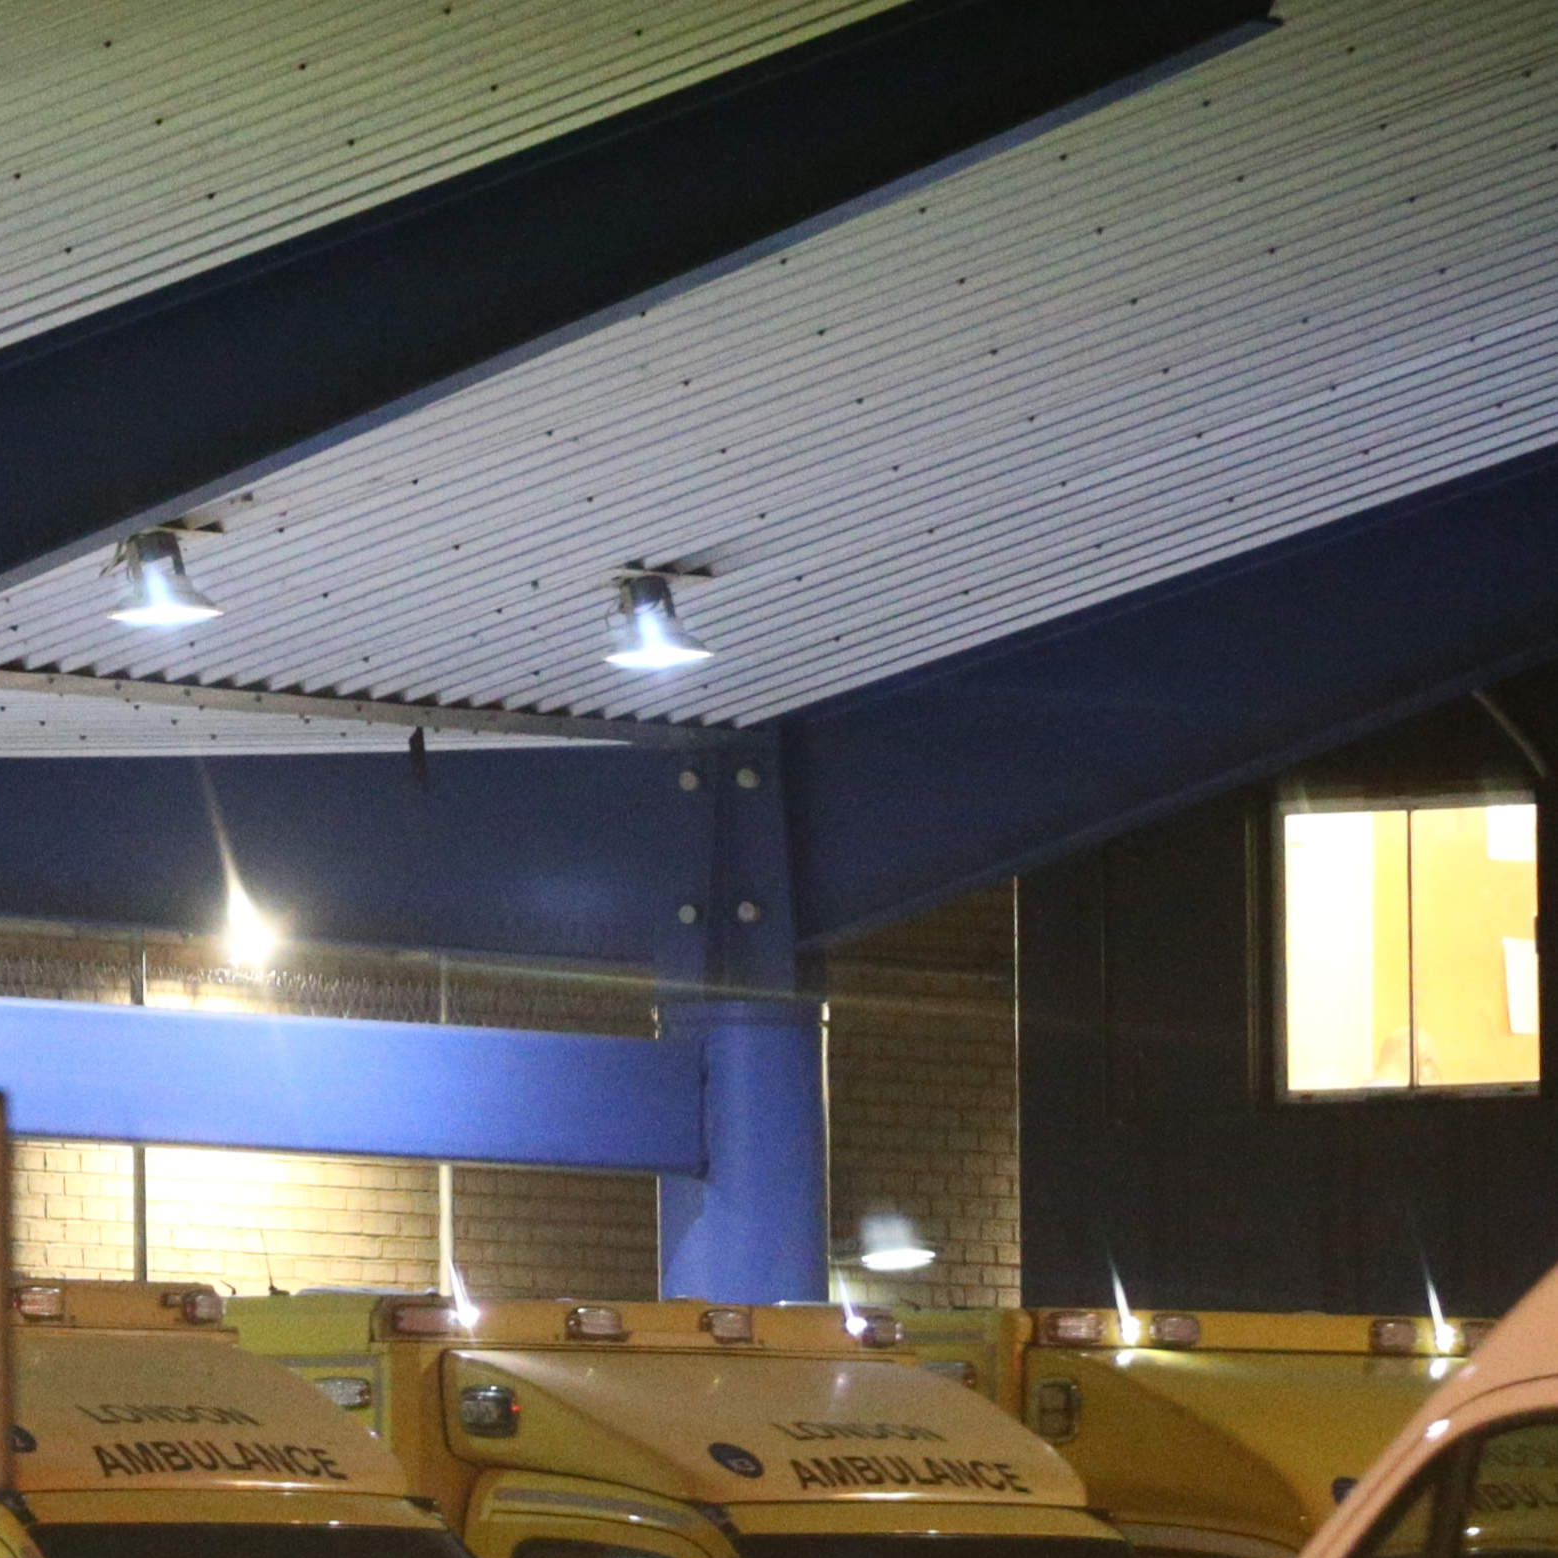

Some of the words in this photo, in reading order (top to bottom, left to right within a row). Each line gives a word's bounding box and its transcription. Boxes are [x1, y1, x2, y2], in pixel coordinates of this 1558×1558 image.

[75, 1404, 261, 1426] LONDON
[773, 1421, 947, 1443] LONDON
[92, 1441, 348, 1480] AMBULANCE
[789, 1456, 1032, 1494] AMBULANCE
